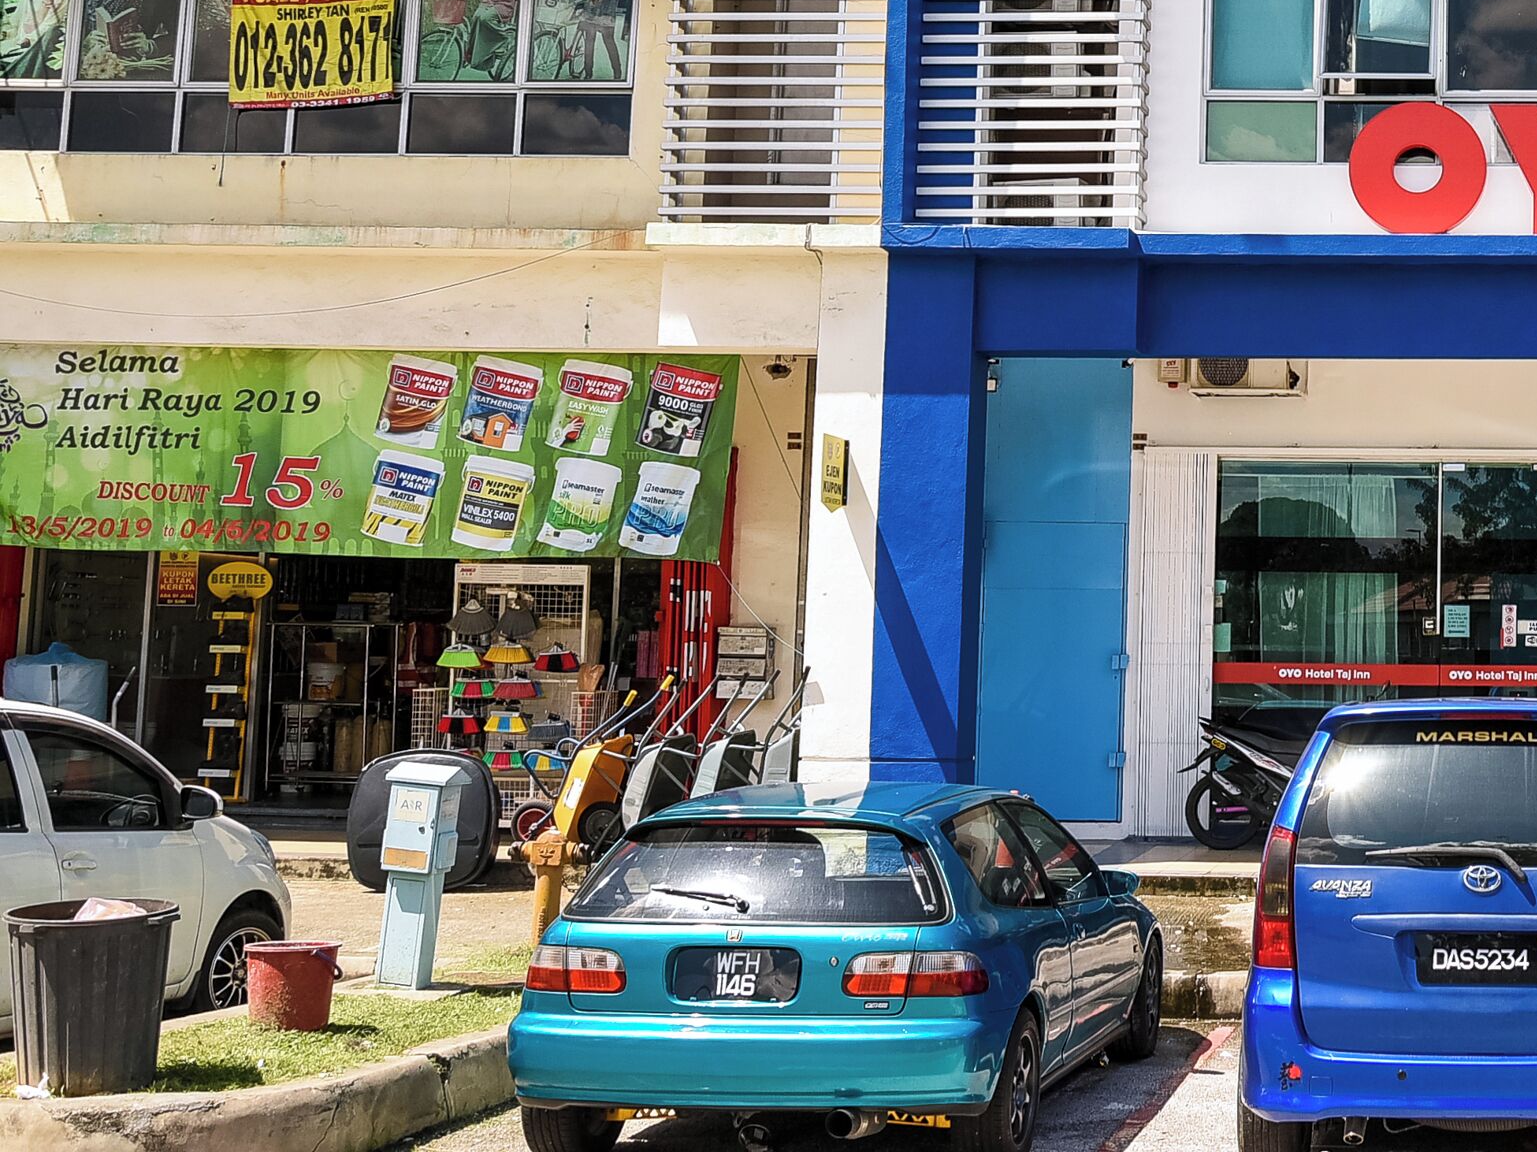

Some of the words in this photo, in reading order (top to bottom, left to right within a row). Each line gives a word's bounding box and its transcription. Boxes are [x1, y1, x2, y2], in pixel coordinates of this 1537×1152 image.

[276, 5, 323, 21] SHIRLEY
[326, 4, 350, 18] TAN
[234, 19, 328, 92] 012-362
[337, 11, 392, 86] 8171
[266, 90, 290, 101] Many
[291, 90, 315, 99] Units
[318, 86, 361, 98] Available
[290, 98, 340, 109] 03-3341
[55, 349, 180, 375] Selama
[411, 373, 450, 388] NIPPON
[495, 375, 535, 390] NIPPON
[584, 379, 624, 393] NIPPON
[675, 375, 716, 391] NIPPON
[413, 381, 447, 395] PAINT
[497, 383, 530, 396] PAINT
[586, 385, 618, 398] PAINT
[677, 383, 711, 397] PAINT
[57, 387, 129, 411] Hari
[137, 388, 223, 418] Raya
[233, 389, 321, 415] 2019
[658, 395, 690, 411] 9000
[54, 424, 201, 456] Aidilfitri
[825, 464, 841, 478] EJEN
[399, 471, 437, 486] NIPPON
[96, 480, 210, 504] DISCOUNT
[400, 479, 431, 493] PAINT
[485, 479, 524, 494] NIPPON
[822, 479, 842, 496] KUPON
[388, 490, 417, 503] MATEX
[487, 488, 519, 500] PAINT
[493, 509, 516, 522] 5400
[162, 523, 175, 538] to
[179, 517, 331, 544] 04/6/2019
[162, 570, 195, 579] KUPON
[163, 577, 192, 585] LETAK
[210, 573, 268, 586] BEETHREE
[160, 583, 195, 592] KERETA
[1278, 668, 1303, 680] OYO
[1304, 668, 1334, 680] Hotel
[1335, 668, 1352, 682] Taj
[1352, 669, 1371, 680] Inn
[1448, 670, 1473, 682] OYO
[1475, 670, 1505, 682] Hotel
[1506, 670, 1523, 683] Taj
[1308, 879, 1372, 893] AVANZA
[717, 951, 761, 974] WFH
[1431, 948, 1530, 971] DAS5234
[715, 973, 757, 997] 1146
